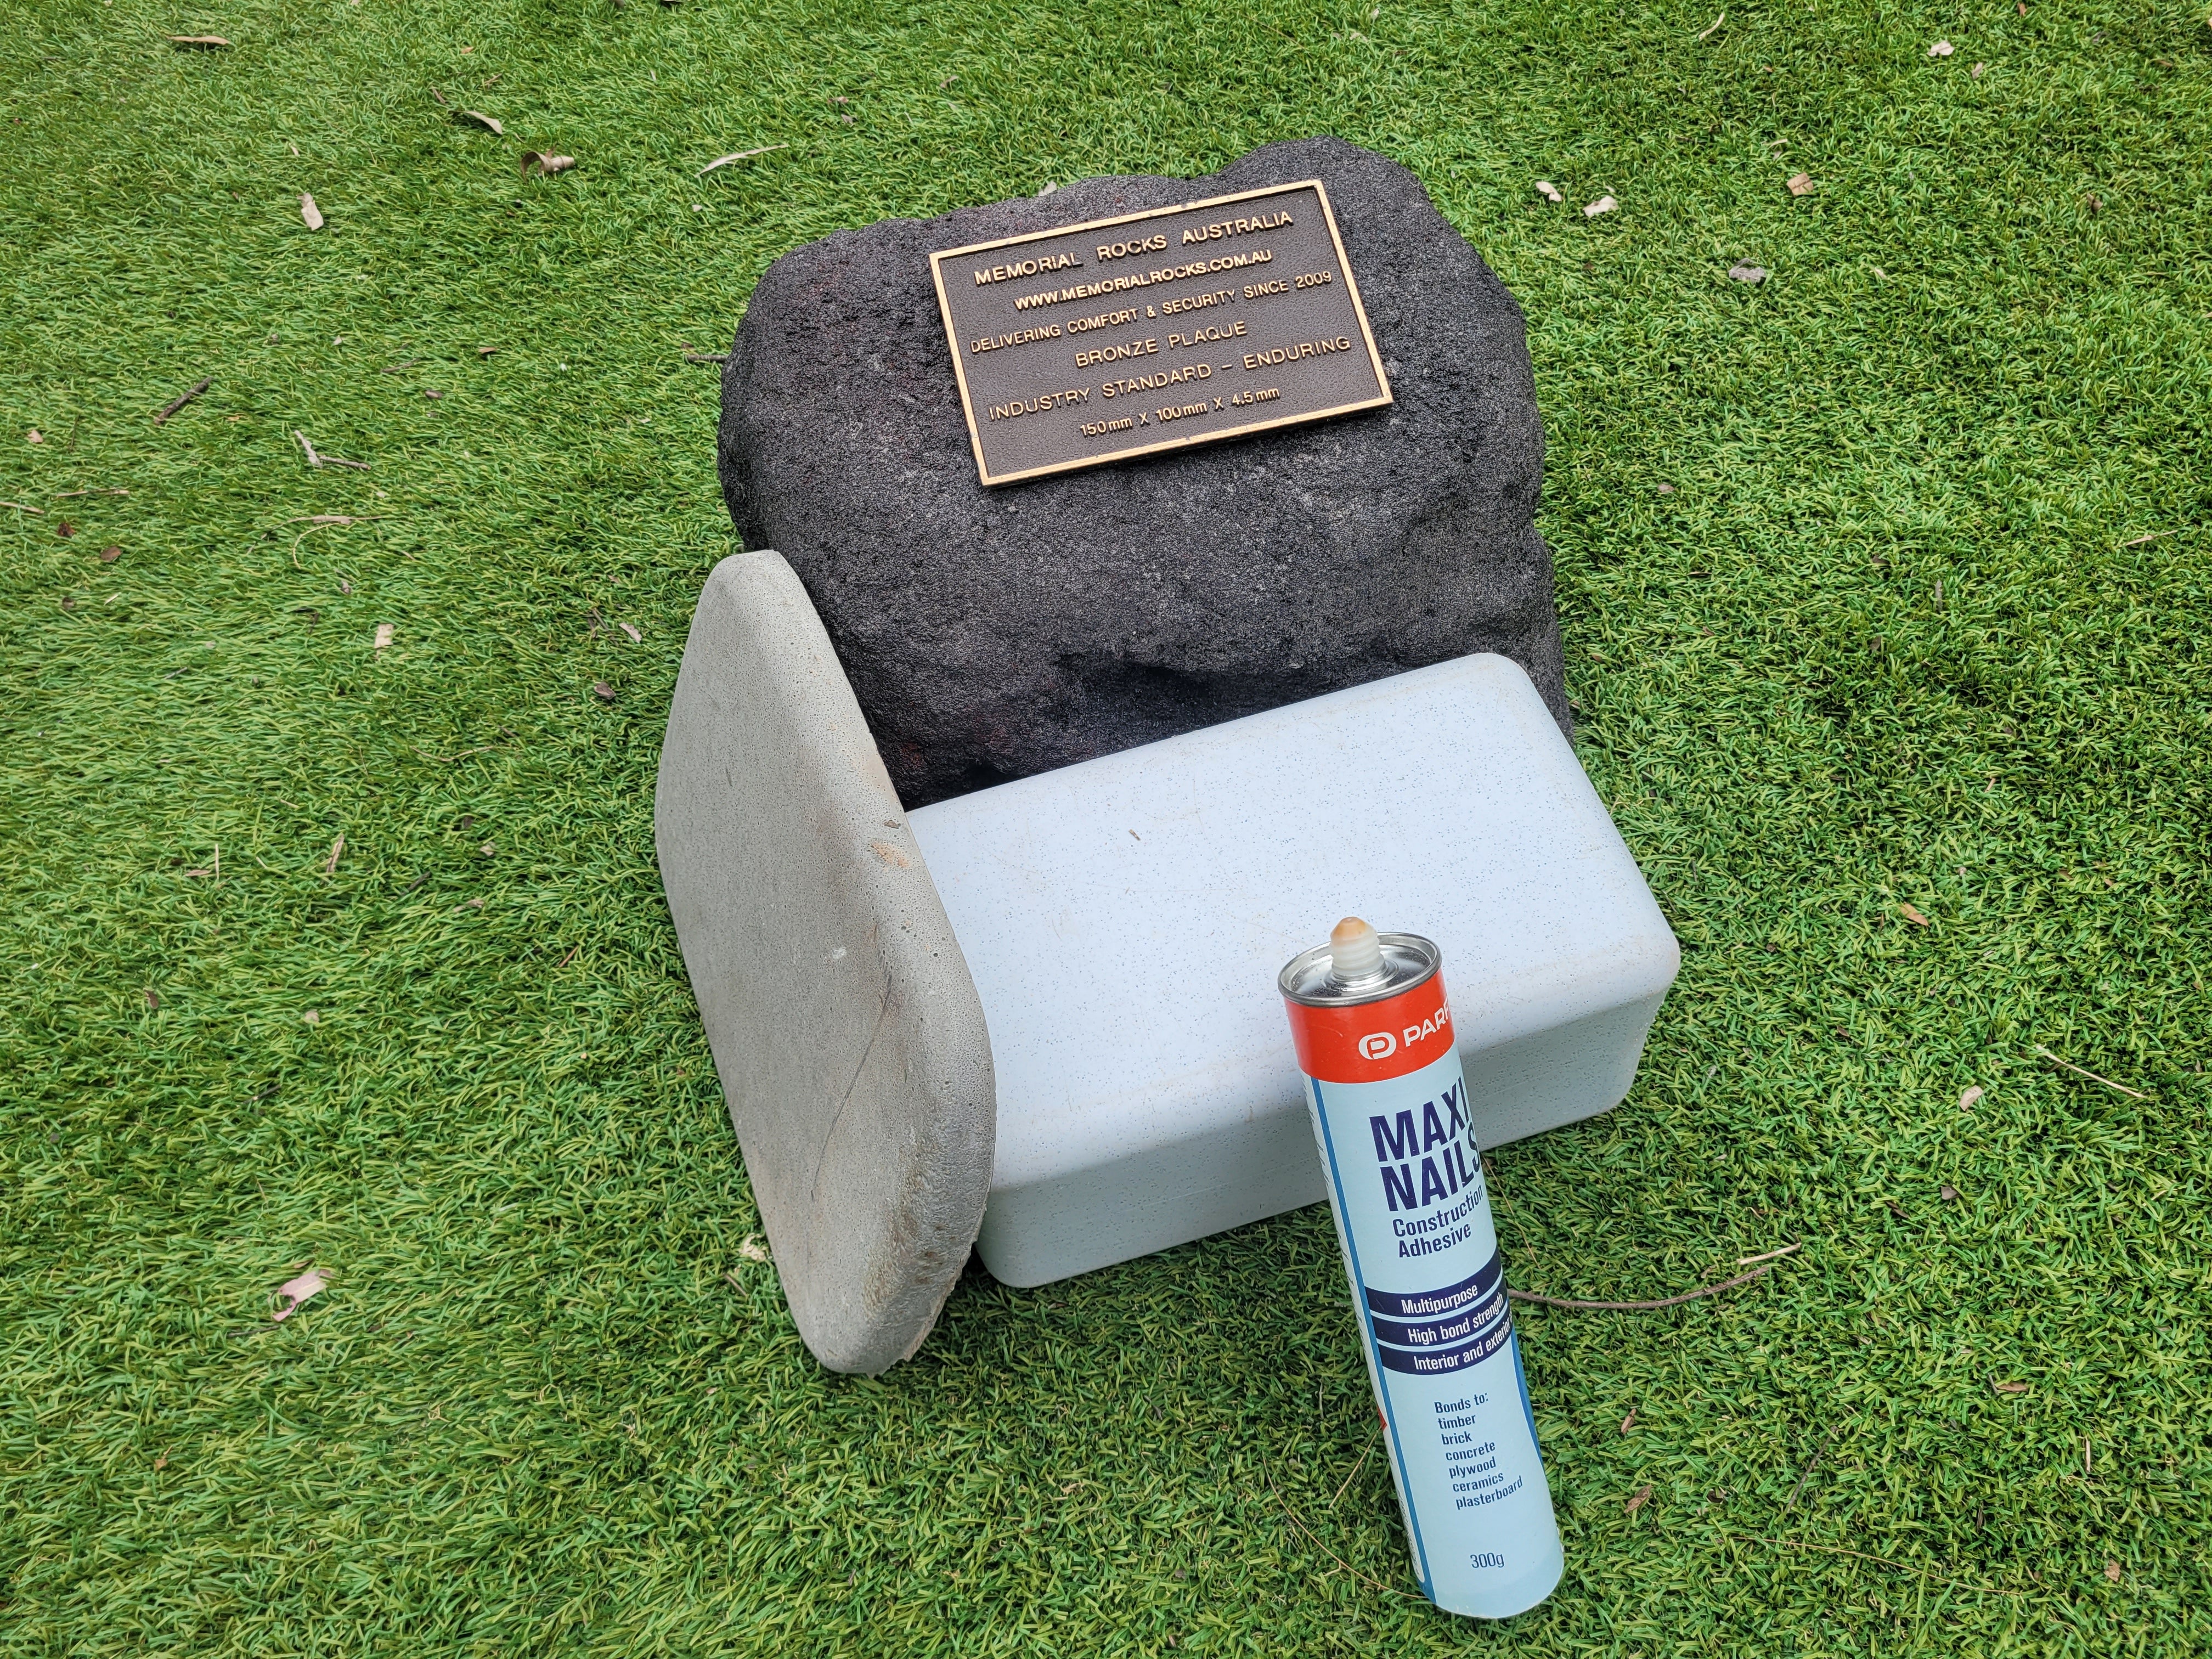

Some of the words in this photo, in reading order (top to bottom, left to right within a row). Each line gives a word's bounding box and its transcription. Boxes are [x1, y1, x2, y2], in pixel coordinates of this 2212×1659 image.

[974, 251, 1083, 285] MEMORIAL
[1097, 234, 1167, 261] ROCKS
[1182, 211, 1293, 245] AUSTRALIA
[1014, 249, 1272, 310] WWW.MEMORIALROCKS.COM.AU
[972, 323, 1061, 354] DELIVERING
[1067, 308, 1138, 334] COMFORT
[1147, 305, 1156, 318] &
[1162, 289, 1235, 315] SECURITY
[1244, 279, 1288, 298] SINCE
[1295, 270, 1331, 290] 2009
[1075, 338, 1158, 368] BRONZE
[1169, 321, 1247, 349] PLAQUE
[990, 387, 1090, 420] INDUSTRY
[1102, 364, 1211, 398] STANDARD
[1243, 336, 1351, 370] ENDURING
[1139, 413, 1149, 426] X
[1213, 397, 1224, 411] X
[1369, 1075, 1469, 1163] MAXI
[1380, 1122, 1481, 1212] NAILS
[1392, 1184, 1483, 1237] Construction
[1398, 1223, 1471, 1258] Adhesive
[1401, 1284, 1478, 1314] Multipurpose
[1407, 1327, 1437, 1345] High
[1441, 1318, 1470, 1340] bond
[1473, 1292, 1503, 1328] strength
[1414, 1355, 1459, 1370] Interior
[1463, 1341, 1483, 1363] and
[1486, 1317, 1510, 1351] exterior
[1435, 1398, 1471, 1413] Bonds
[1474, 1392, 1489, 1405] to:
[1438, 1413, 1476, 1429] timber
[1441, 1431, 1472, 1445] brick
[1446, 1441, 1496, 1460] concrete
[1449, 1457, 1496, 1479] plywood
[1453, 1471, 1504, 1492] ceramics
[1456, 1475, 1523, 1510] plasterboard
[1470, 1552, 1505, 1568] 300g
